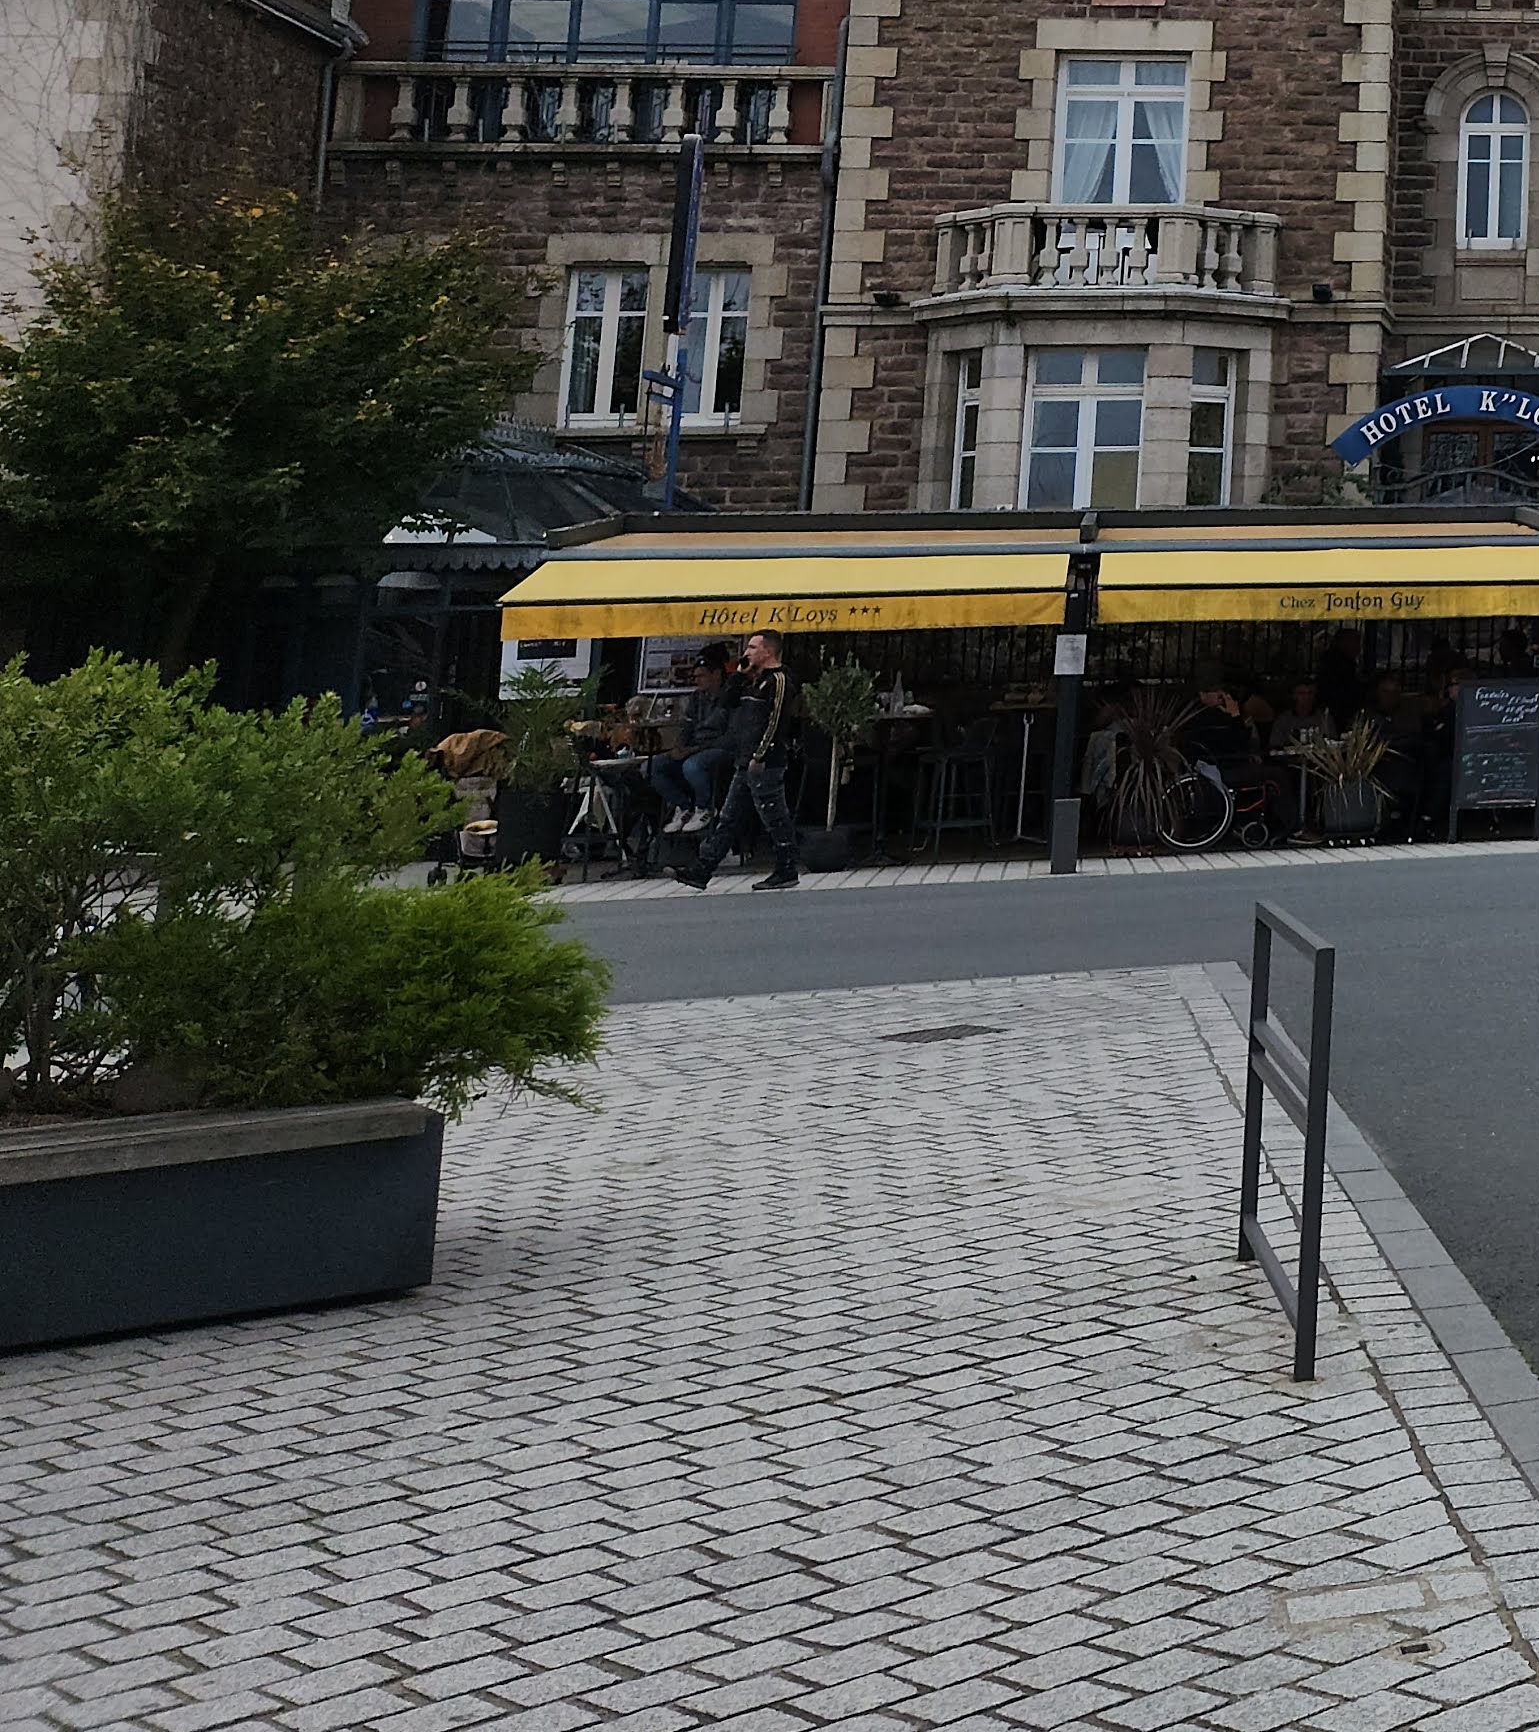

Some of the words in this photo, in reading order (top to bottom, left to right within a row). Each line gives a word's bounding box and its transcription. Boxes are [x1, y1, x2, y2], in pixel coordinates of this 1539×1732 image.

[1359, 393, 1450, 446] HOTEL
[1280, 596, 1315, 609] Chez
[1323, 590, 1383, 611] Tonton
[1391, 591, 1425, 610] Guy
[699, 606, 758, 625] Hôtel
